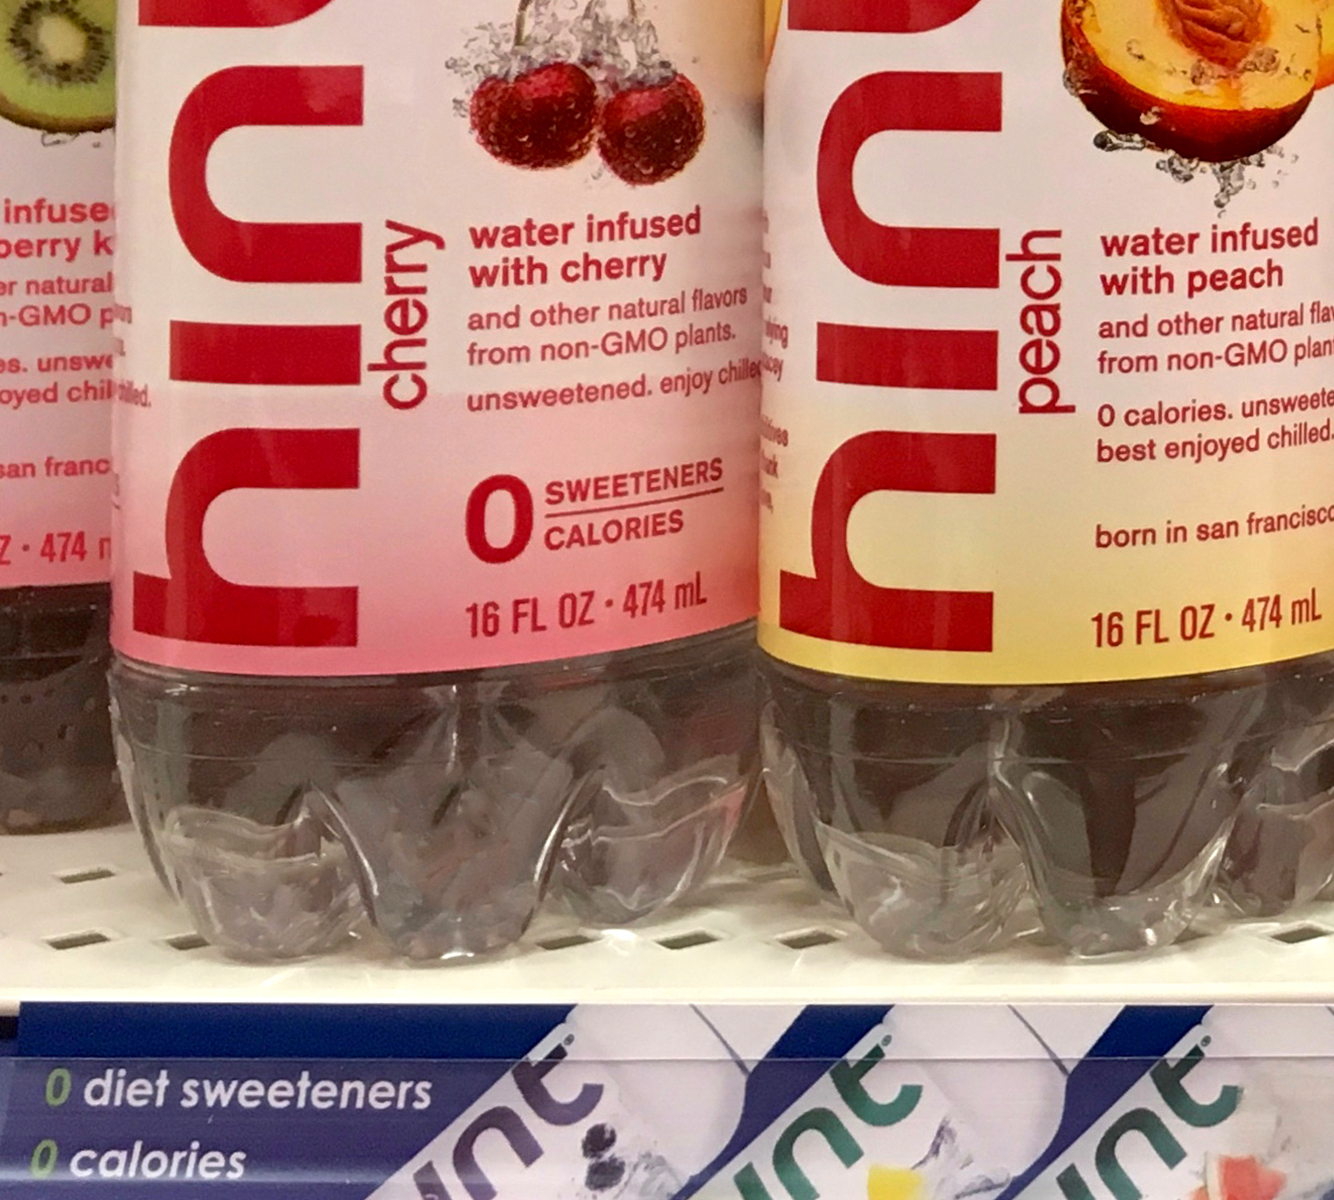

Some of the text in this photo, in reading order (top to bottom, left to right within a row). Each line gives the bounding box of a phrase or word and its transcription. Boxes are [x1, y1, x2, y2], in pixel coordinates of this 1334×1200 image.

[469, 205, 701, 249] water infused
[1101, 217, 1318, 257] water infused
[26, 272, 112, 295] natural
[469, 252, 667, 288] with cherry
[1100, 259, 1283, 299] with peach
[367, 220, 445, 410] cherry
[468, 287, 747, 331] and other natural flavors
[1006, 230, 1076, 414] peach
[1099, 314, 1148, 339] and
[1158, 312, 1224, 336] other
[1232, 303, 1303, 331] natural
[467, 322, 736, 366] from non-GMO plants.
[1098, 350, 1157, 374] from
[1167, 339, 1287, 371] non-GMO
[467, 368, 714, 412] unsweetened. enjoy
[1124, 399, 1232, 426] calories.
[1097, 418, 1334, 463] best enjoyed chilled.
[545, 457, 723, 505] SWEETENERS
[466, 475, 533, 564] 0
[544, 509, 684, 550] CALORIES
[1096, 524, 1156, 548] born
[1197, 521, 1238, 541] san
[40, 531, 87, 562] 474
[466, 579, 666, 638] 16 FL OZ 474
[46, 1069, 431, 1109] 0 diet sweeteners
[69, 1141, 246, 1179] calories
